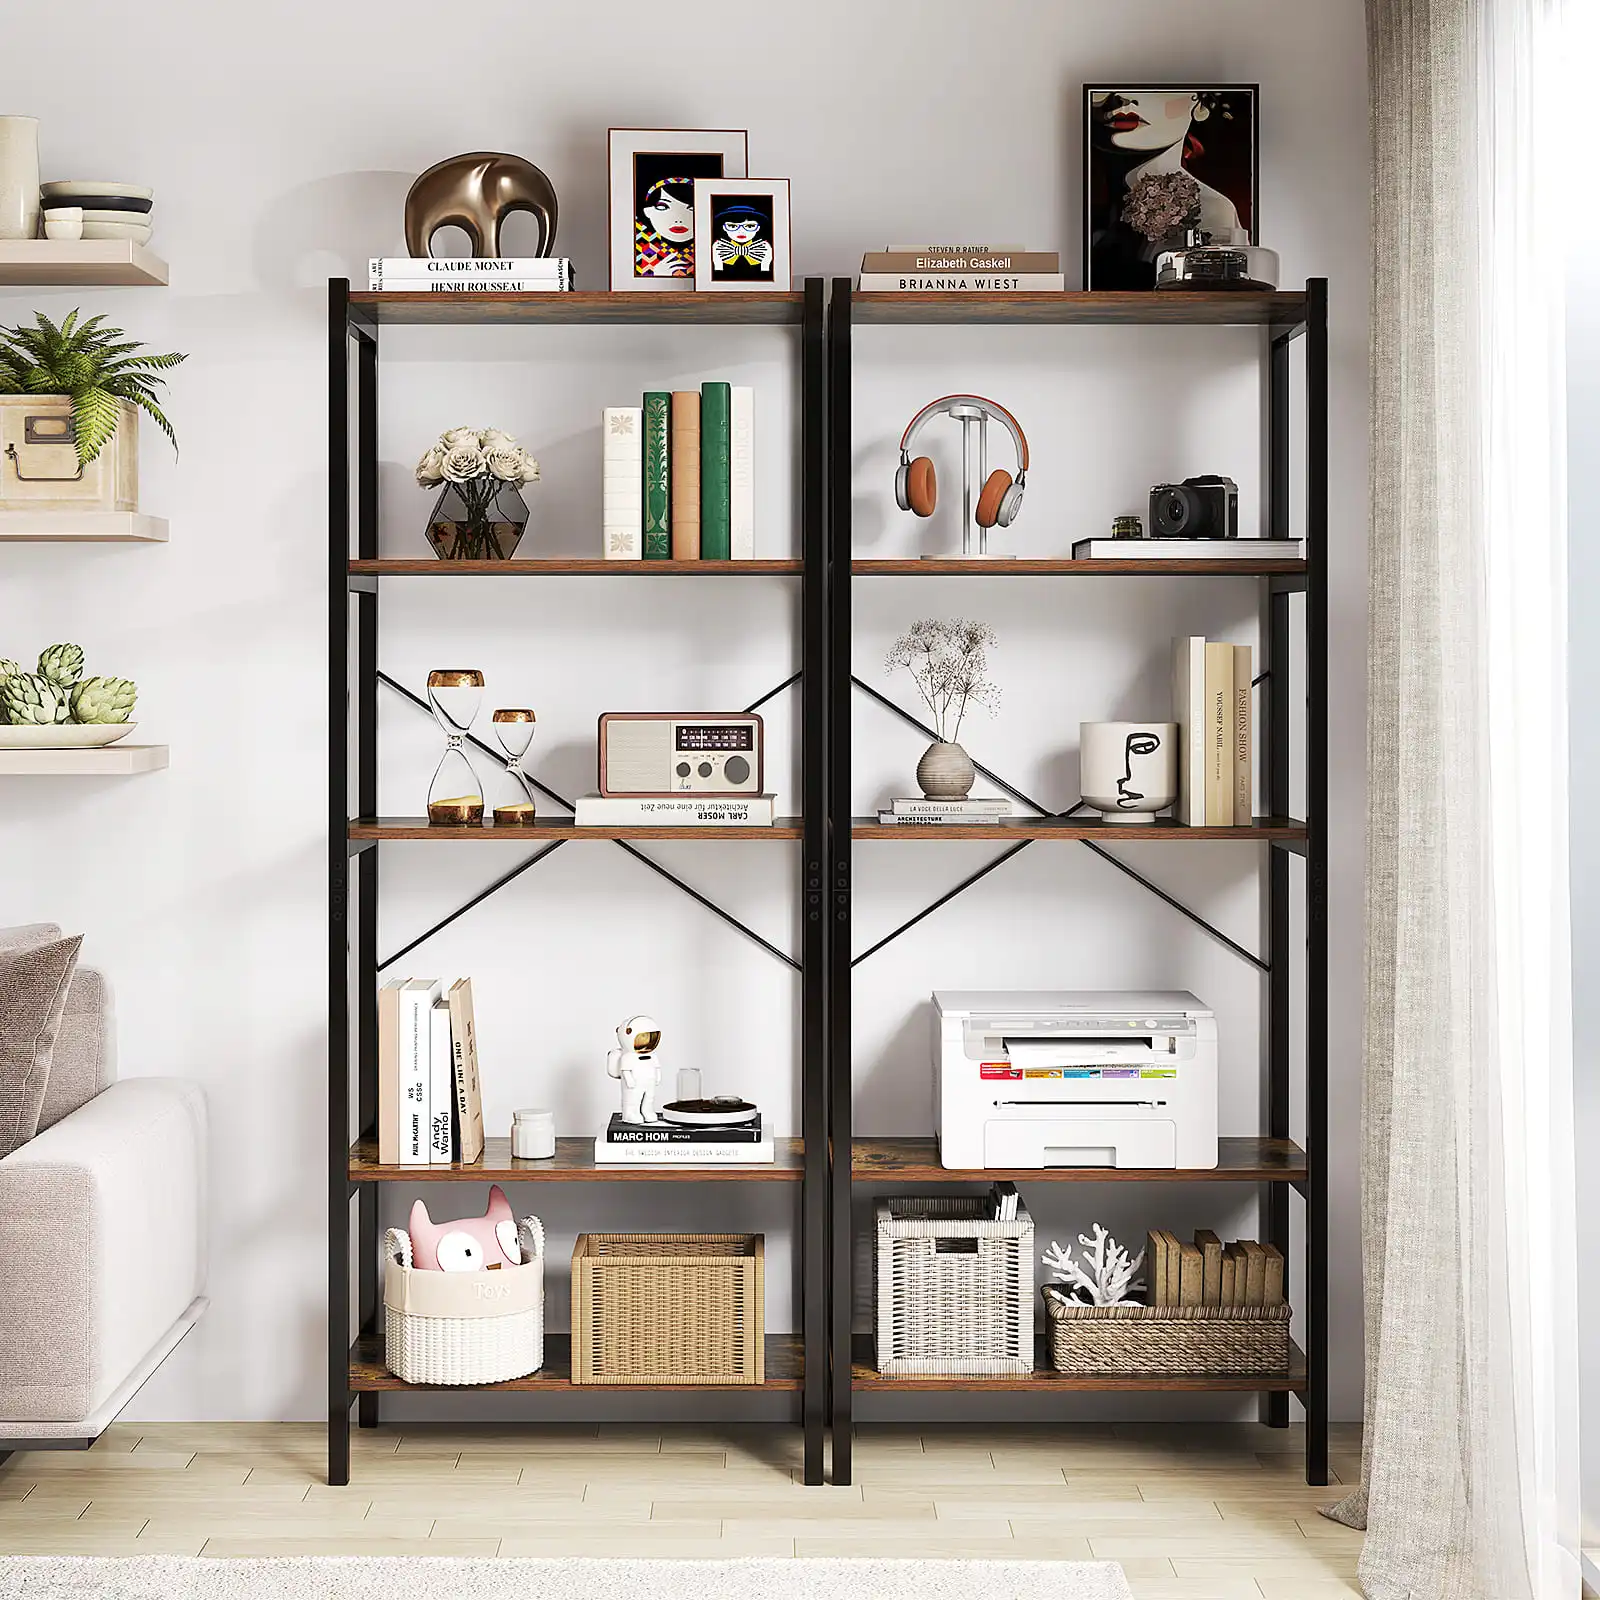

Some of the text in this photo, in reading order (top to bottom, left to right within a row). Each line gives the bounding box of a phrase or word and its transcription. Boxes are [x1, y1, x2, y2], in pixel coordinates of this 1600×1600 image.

[427, 260, 514, 272] CLAUDE MONET
[916, 257, 1011, 269] Elizabeth Gaskell
[431, 281, 525, 292] HENRI ROUSSEAU
[899, 278, 1019, 289] BRIANNA WIEST
[1238, 689, 1247, 762] FASHION SHOW
[640, 803, 656, 812] Zeit
[657, 803, 675, 811] neue
[676, 803, 693, 812] eine
[707, 803, 748, 812] Architektur
[697, 811, 748, 820] CARL MOSER
[408, 1087, 414, 1099] WS
[459, 1097, 467, 1114] DAY
[432, 1117, 442, 1150] Andy
[440, 1111, 449, 1155] Warhol
[613, 1132, 643, 1141] MARC
[645, 1132, 669, 1141] HOM
[473, 1281, 511, 1300] Toys
